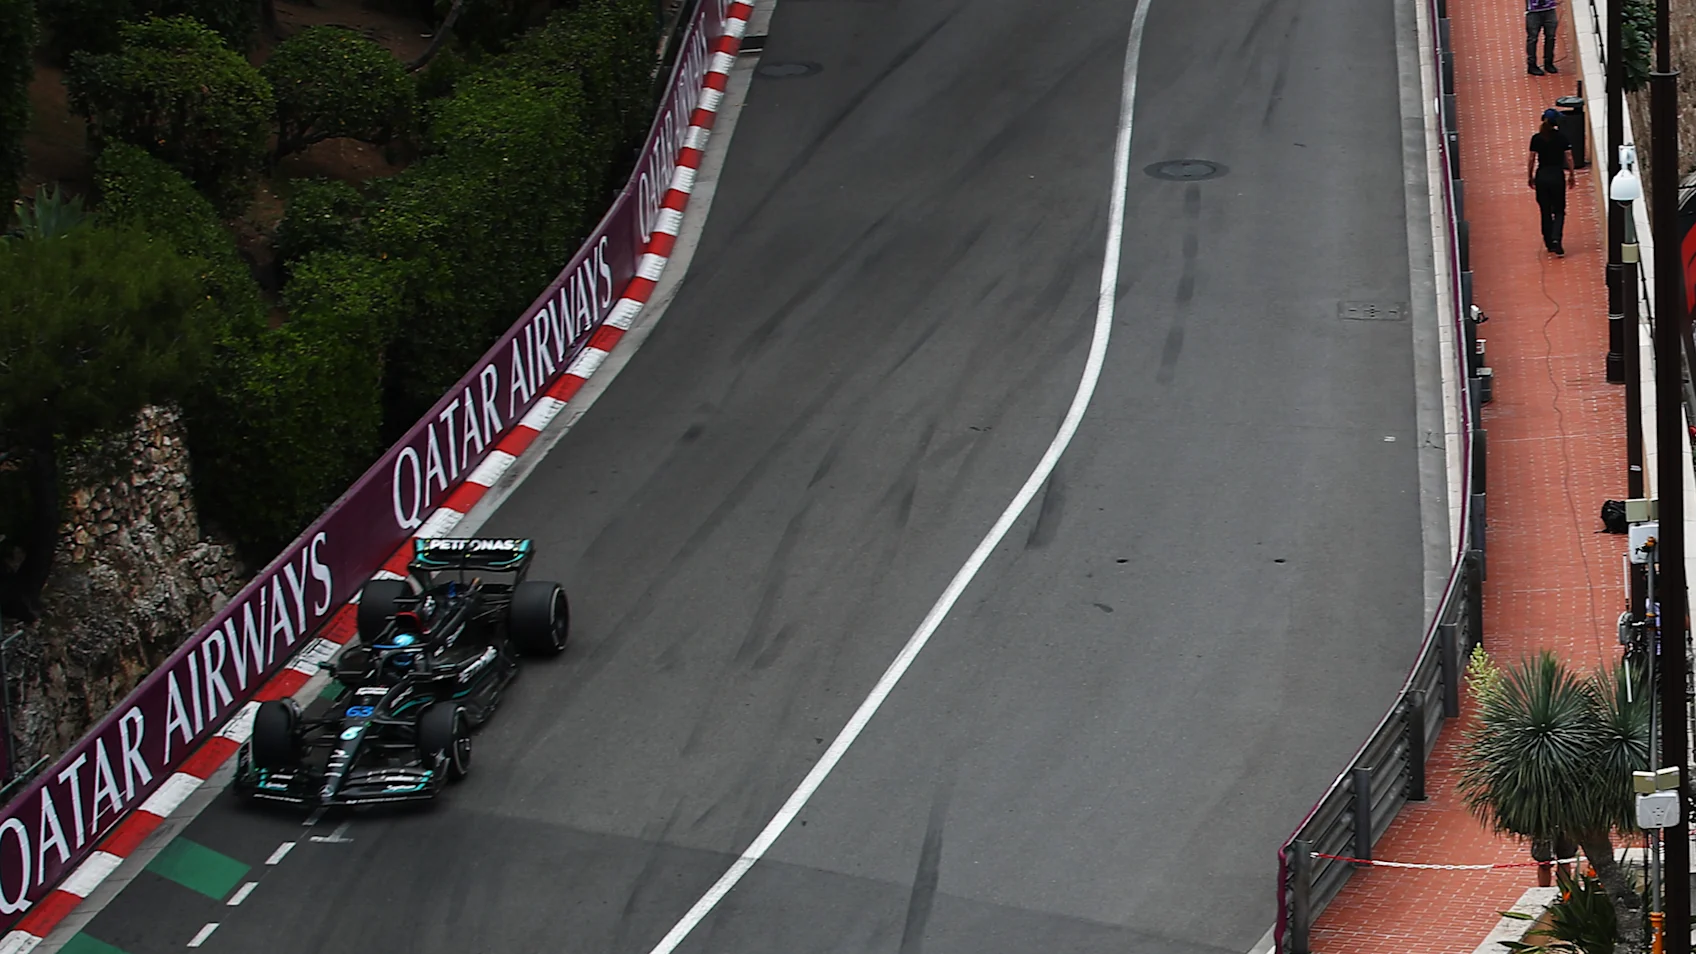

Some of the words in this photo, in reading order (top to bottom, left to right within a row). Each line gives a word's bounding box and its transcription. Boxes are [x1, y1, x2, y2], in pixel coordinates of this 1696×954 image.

[392, 363, 504, 531] QATAR
[508, 235, 613, 420] AIRWAYS
[0, 706, 153, 915] QATAR
[163, 531, 333, 766] AIRWAYS
[346, 705, 374, 717] 63
